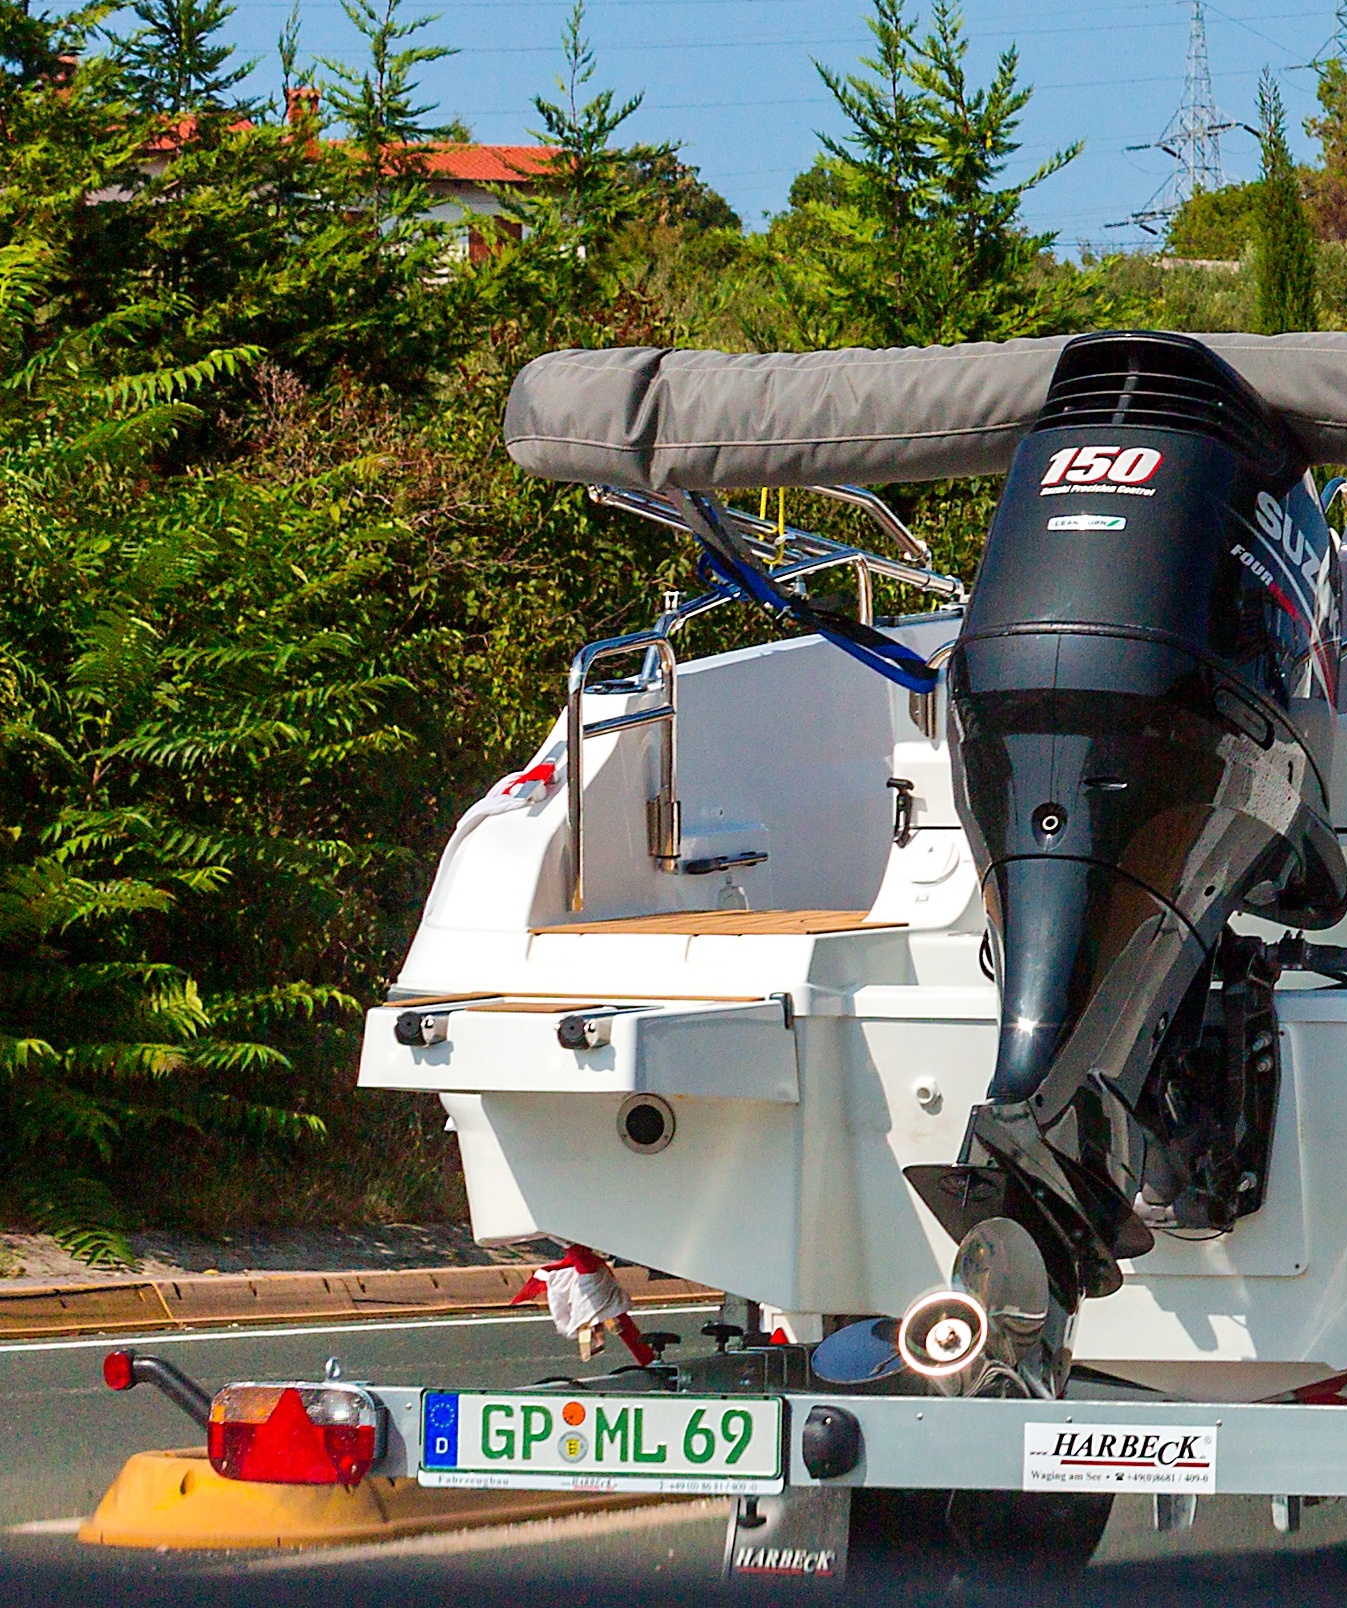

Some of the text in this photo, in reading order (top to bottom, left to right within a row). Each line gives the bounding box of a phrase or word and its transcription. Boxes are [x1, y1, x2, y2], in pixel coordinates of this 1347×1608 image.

[1040, 446, 1164, 486] 150
[435, 1437, 448, 1454] D
[481, 1403, 753, 1465] GP ML 69
[1052, 1433, 1201, 1465] HARBECK
[1031, 1470, 1066, 1482] Waging
[1069, 1473, 1083, 1481] am
[735, 1547, 832, 1573] HARBECK
